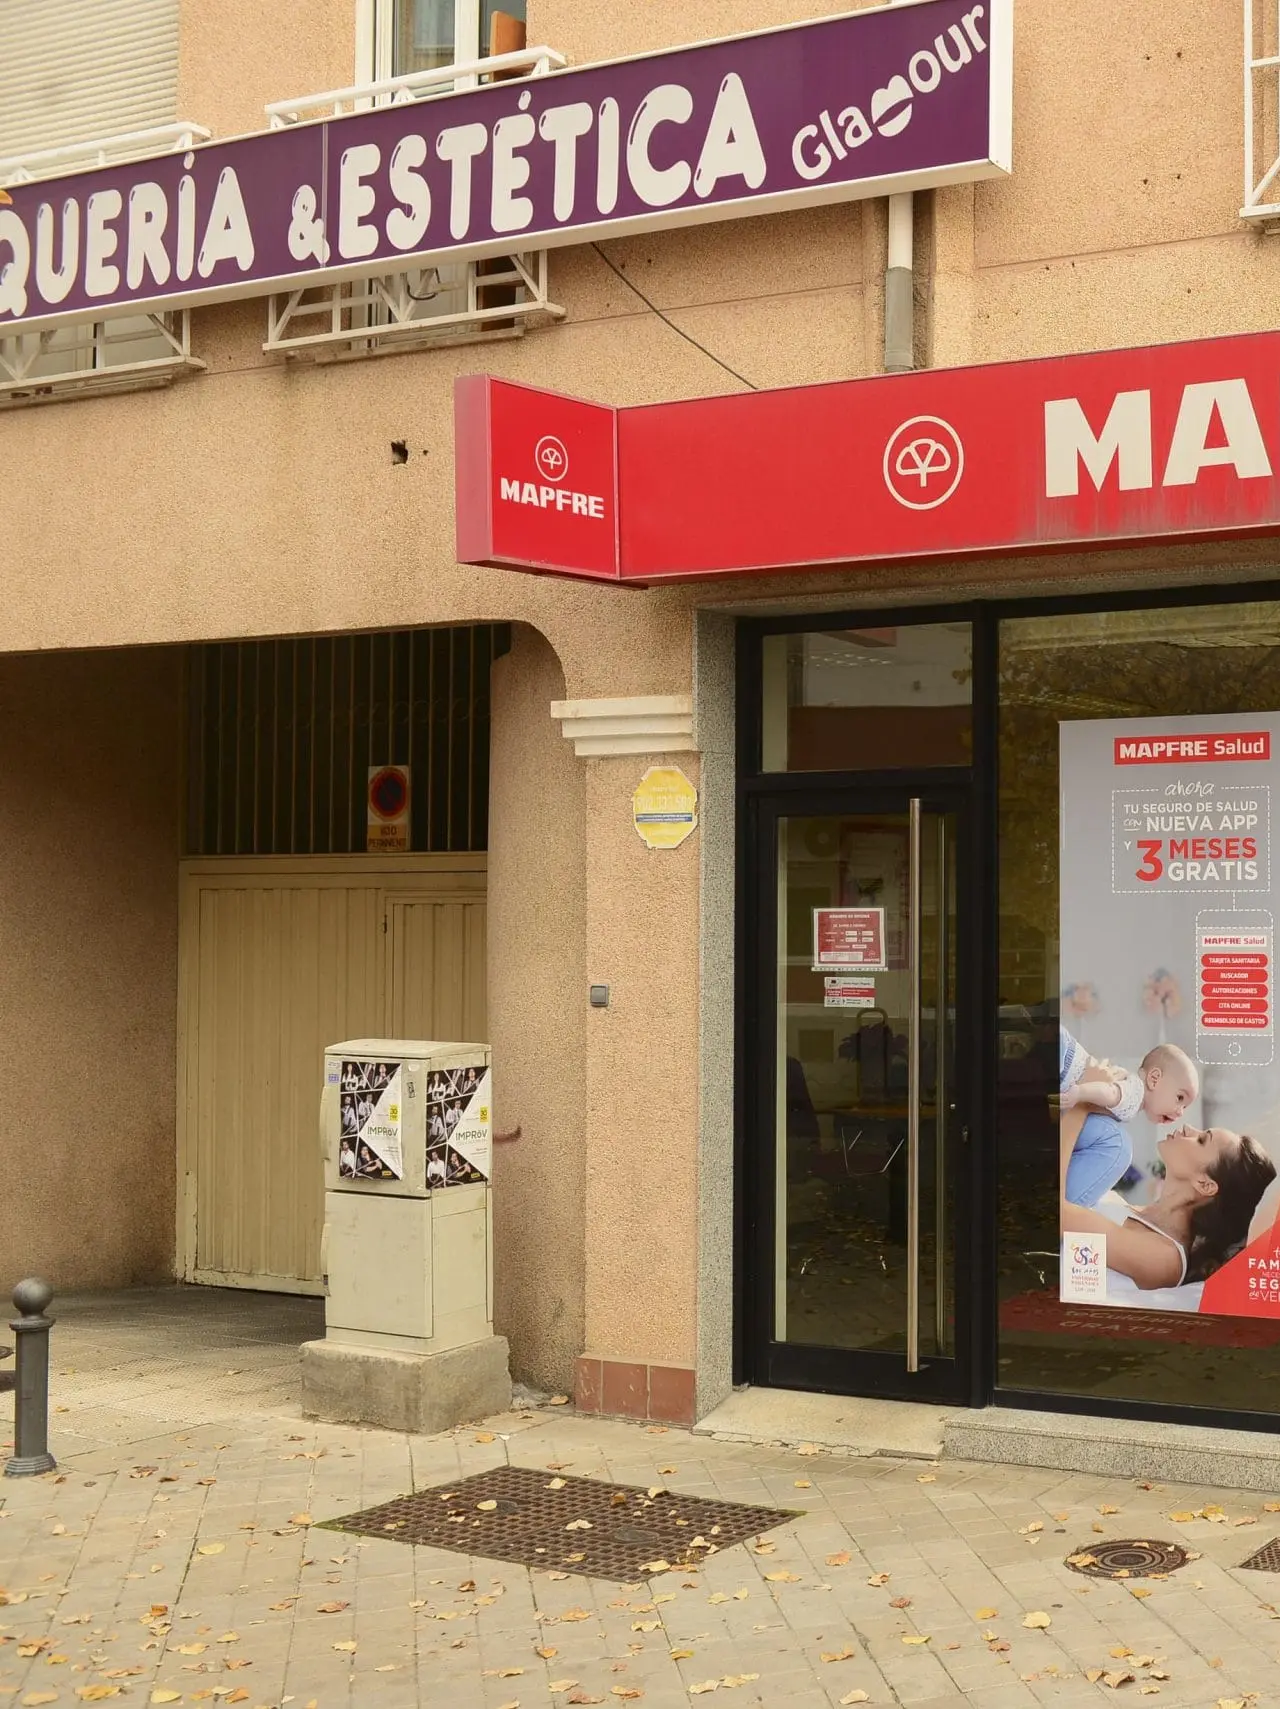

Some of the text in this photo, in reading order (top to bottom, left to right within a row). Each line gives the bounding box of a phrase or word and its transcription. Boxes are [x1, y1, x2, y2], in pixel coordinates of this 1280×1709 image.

[288, 185, 330, 264] &
[338, 72, 767, 259] ESTÉTICA
[501, 477, 604, 519] MAPFRE
[1119, 738, 1264, 759] MAPFRE Salud
[1164, 780, 1214, 796] ahora
[1124, 801, 1258, 814] TU SEGURO DE SALUD
[1146, 815, 1213, 832] NUEVA
[1219, 814, 1258, 830] APP
[1124, 837, 1257, 882] Y 3 MESES
[1168, 861, 1258, 882] GRATIS
[1204, 937, 1265, 945] MAPFRE Salud
